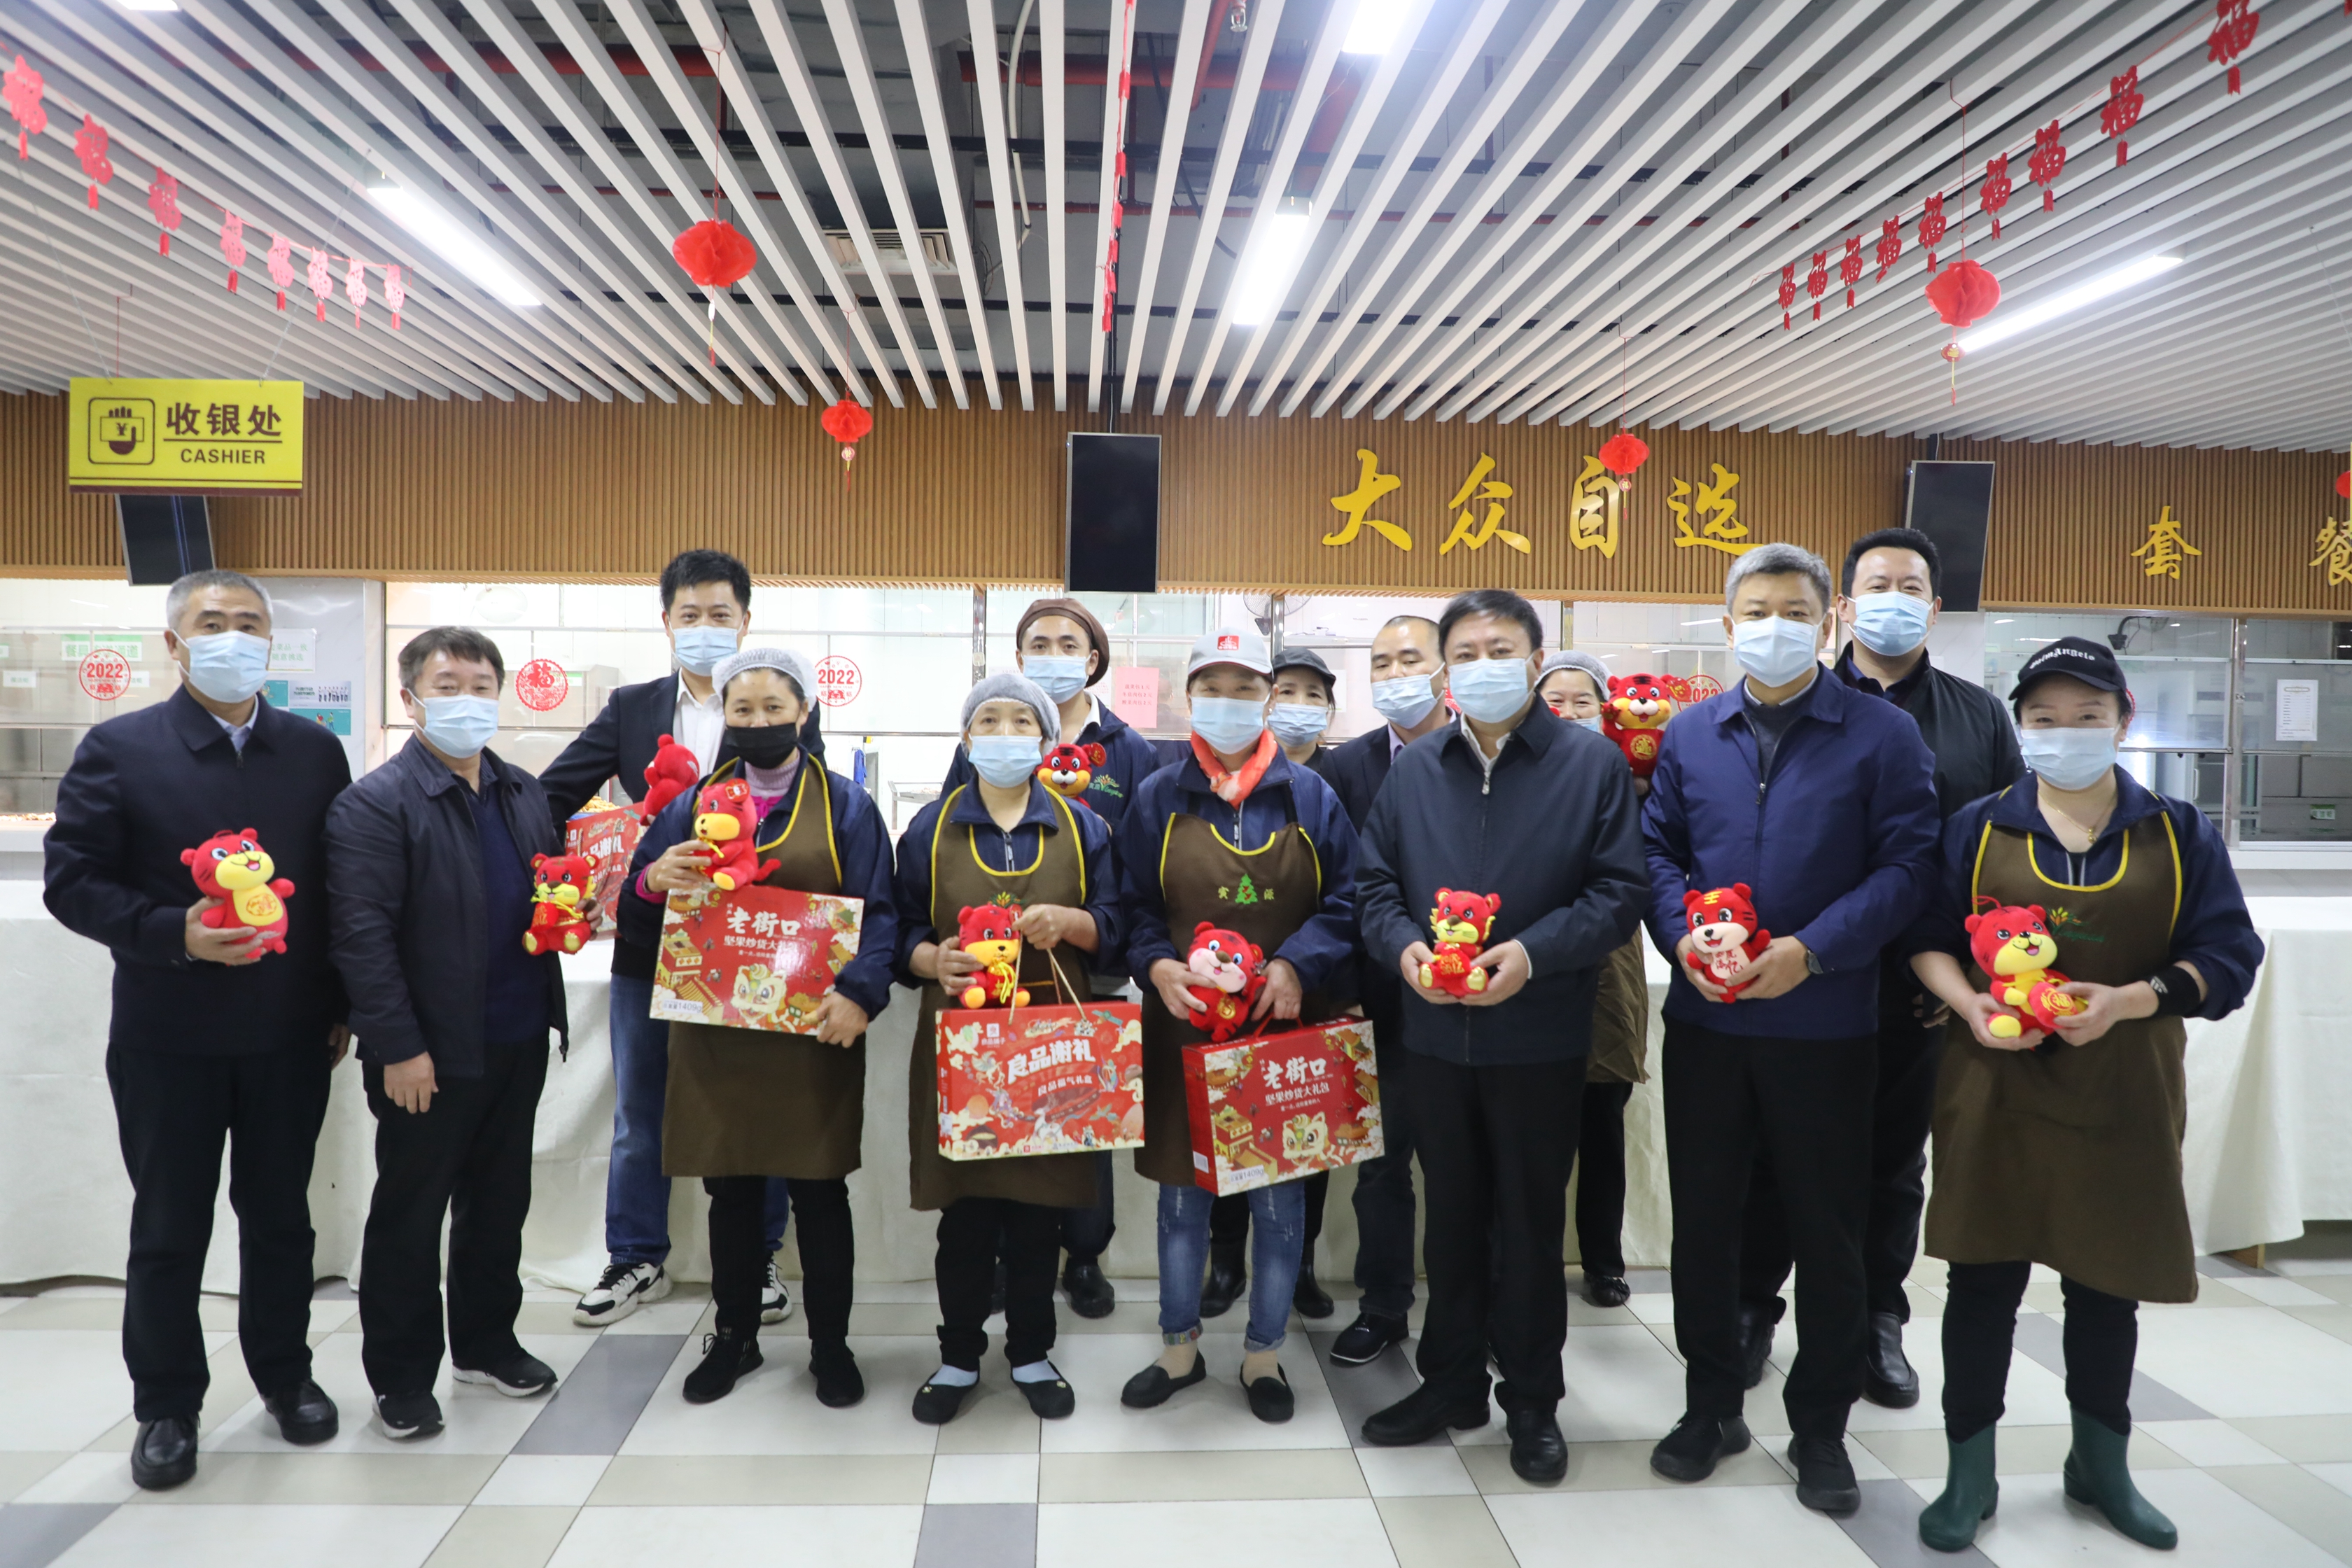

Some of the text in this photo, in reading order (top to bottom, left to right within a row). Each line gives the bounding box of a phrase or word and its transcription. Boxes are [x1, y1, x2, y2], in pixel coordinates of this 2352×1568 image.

[2101, 65, 2142, 139] 福
[2028, 120, 2066, 187] 福
[1980, 152, 2012, 216] 福
[1877, 216, 1902, 269] 福
[1919, 191, 1946, 249] 福
[1807, 250, 1828, 299] 福
[1840, 234, 1863, 286] 福
[1778, 262, 1796, 309] 福
[167, 402, 281, 437] 收银处
[181, 449, 265, 465] CASHIER
[1322, 449, 1764, 559] 大众自选
[87, 662, 123, 678] 2022
[818, 668, 855, 685] 2022
[727, 906, 802, 938] 老街口
[1008, 1039, 1096, 1084] 良品谢礼
[1263, 1056, 1326, 1089] 老街口
[1037, 1075, 1093, 1096] 良品福气礼盒
